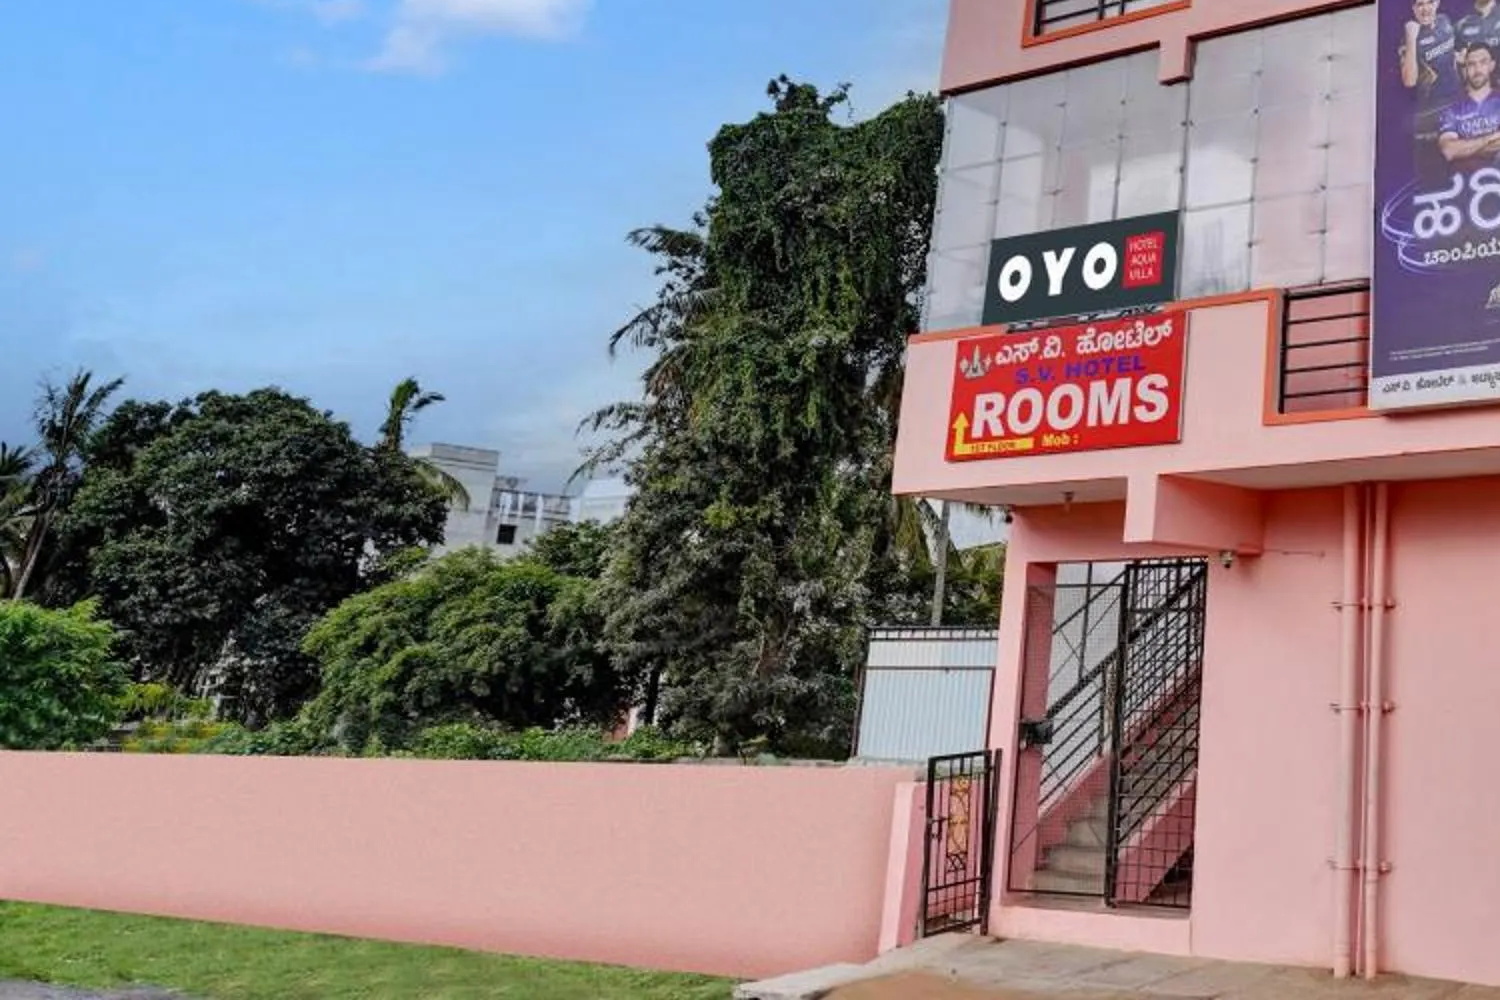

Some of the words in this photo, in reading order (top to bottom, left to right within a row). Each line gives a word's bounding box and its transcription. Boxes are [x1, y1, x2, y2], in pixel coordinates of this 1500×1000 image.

[998, 241, 1118, 302] OYO
[1075, 319, 1173, 354] ಹೋಟೆಲ್
[1065, 352, 1146, 378] HOTEL
[970, 373, 1170, 439] ROOMS
